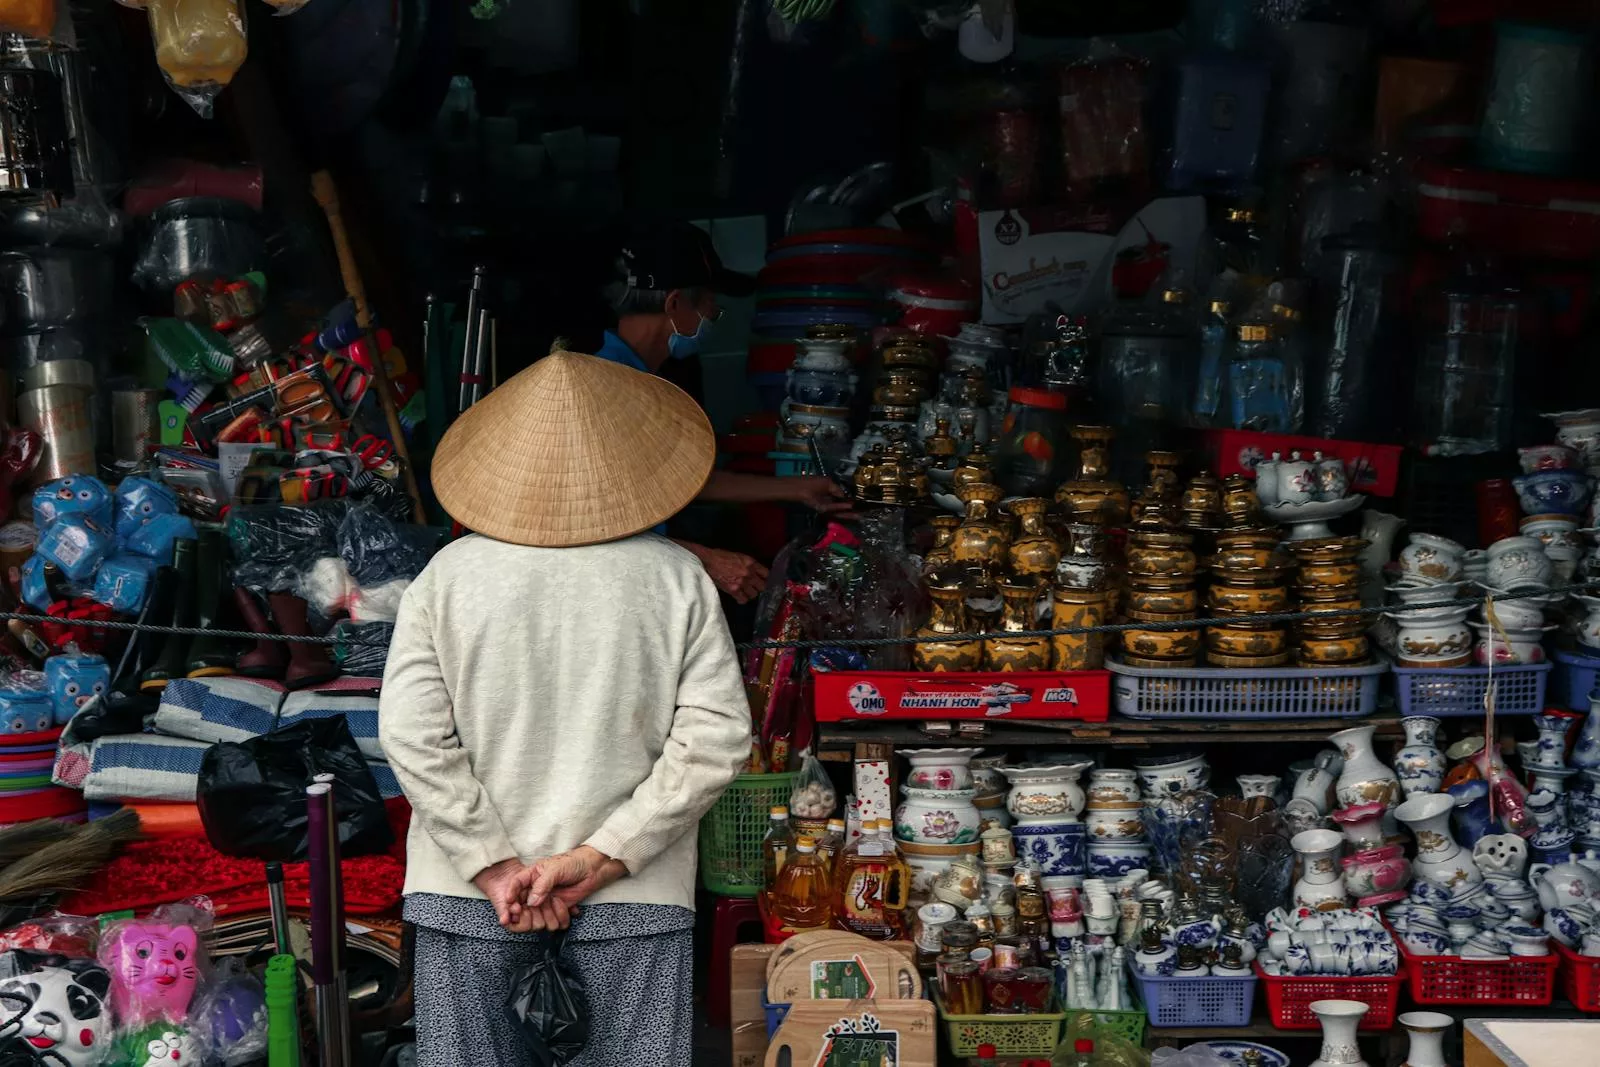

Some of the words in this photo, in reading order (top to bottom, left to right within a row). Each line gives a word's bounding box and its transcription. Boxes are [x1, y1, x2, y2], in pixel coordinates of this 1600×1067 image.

[1045, 689, 1073, 702] MỚI
[861, 697, 885, 709] OMO
[901, 698, 948, 707] NHANH
[951, 697, 980, 707] HƠN
